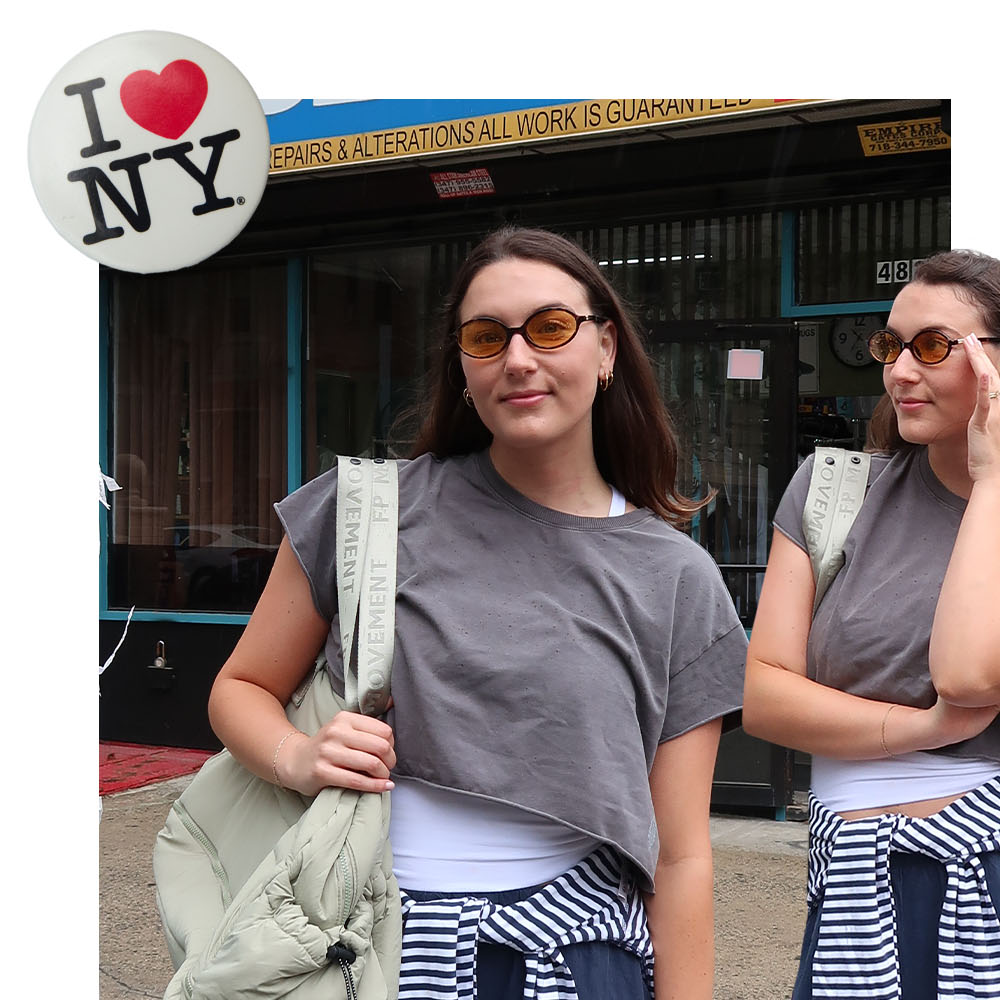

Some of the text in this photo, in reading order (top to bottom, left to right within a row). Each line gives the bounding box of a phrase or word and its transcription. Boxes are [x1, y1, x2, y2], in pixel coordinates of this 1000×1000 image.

[64, 77, 121, 158] I
[270, 141, 332, 169] EPAIRS
[337, 139, 348, 160] &
[353, 120, 475, 159] ALTERATIONS
[478, 116, 512, 142] ALL
[517, 106, 577, 137] WORK
[584, 103, 601, 128] IS
[838, 332, 848, 345] 9
[855, 350, 864, 361] 6
[372, 495, 389, 522] FP
